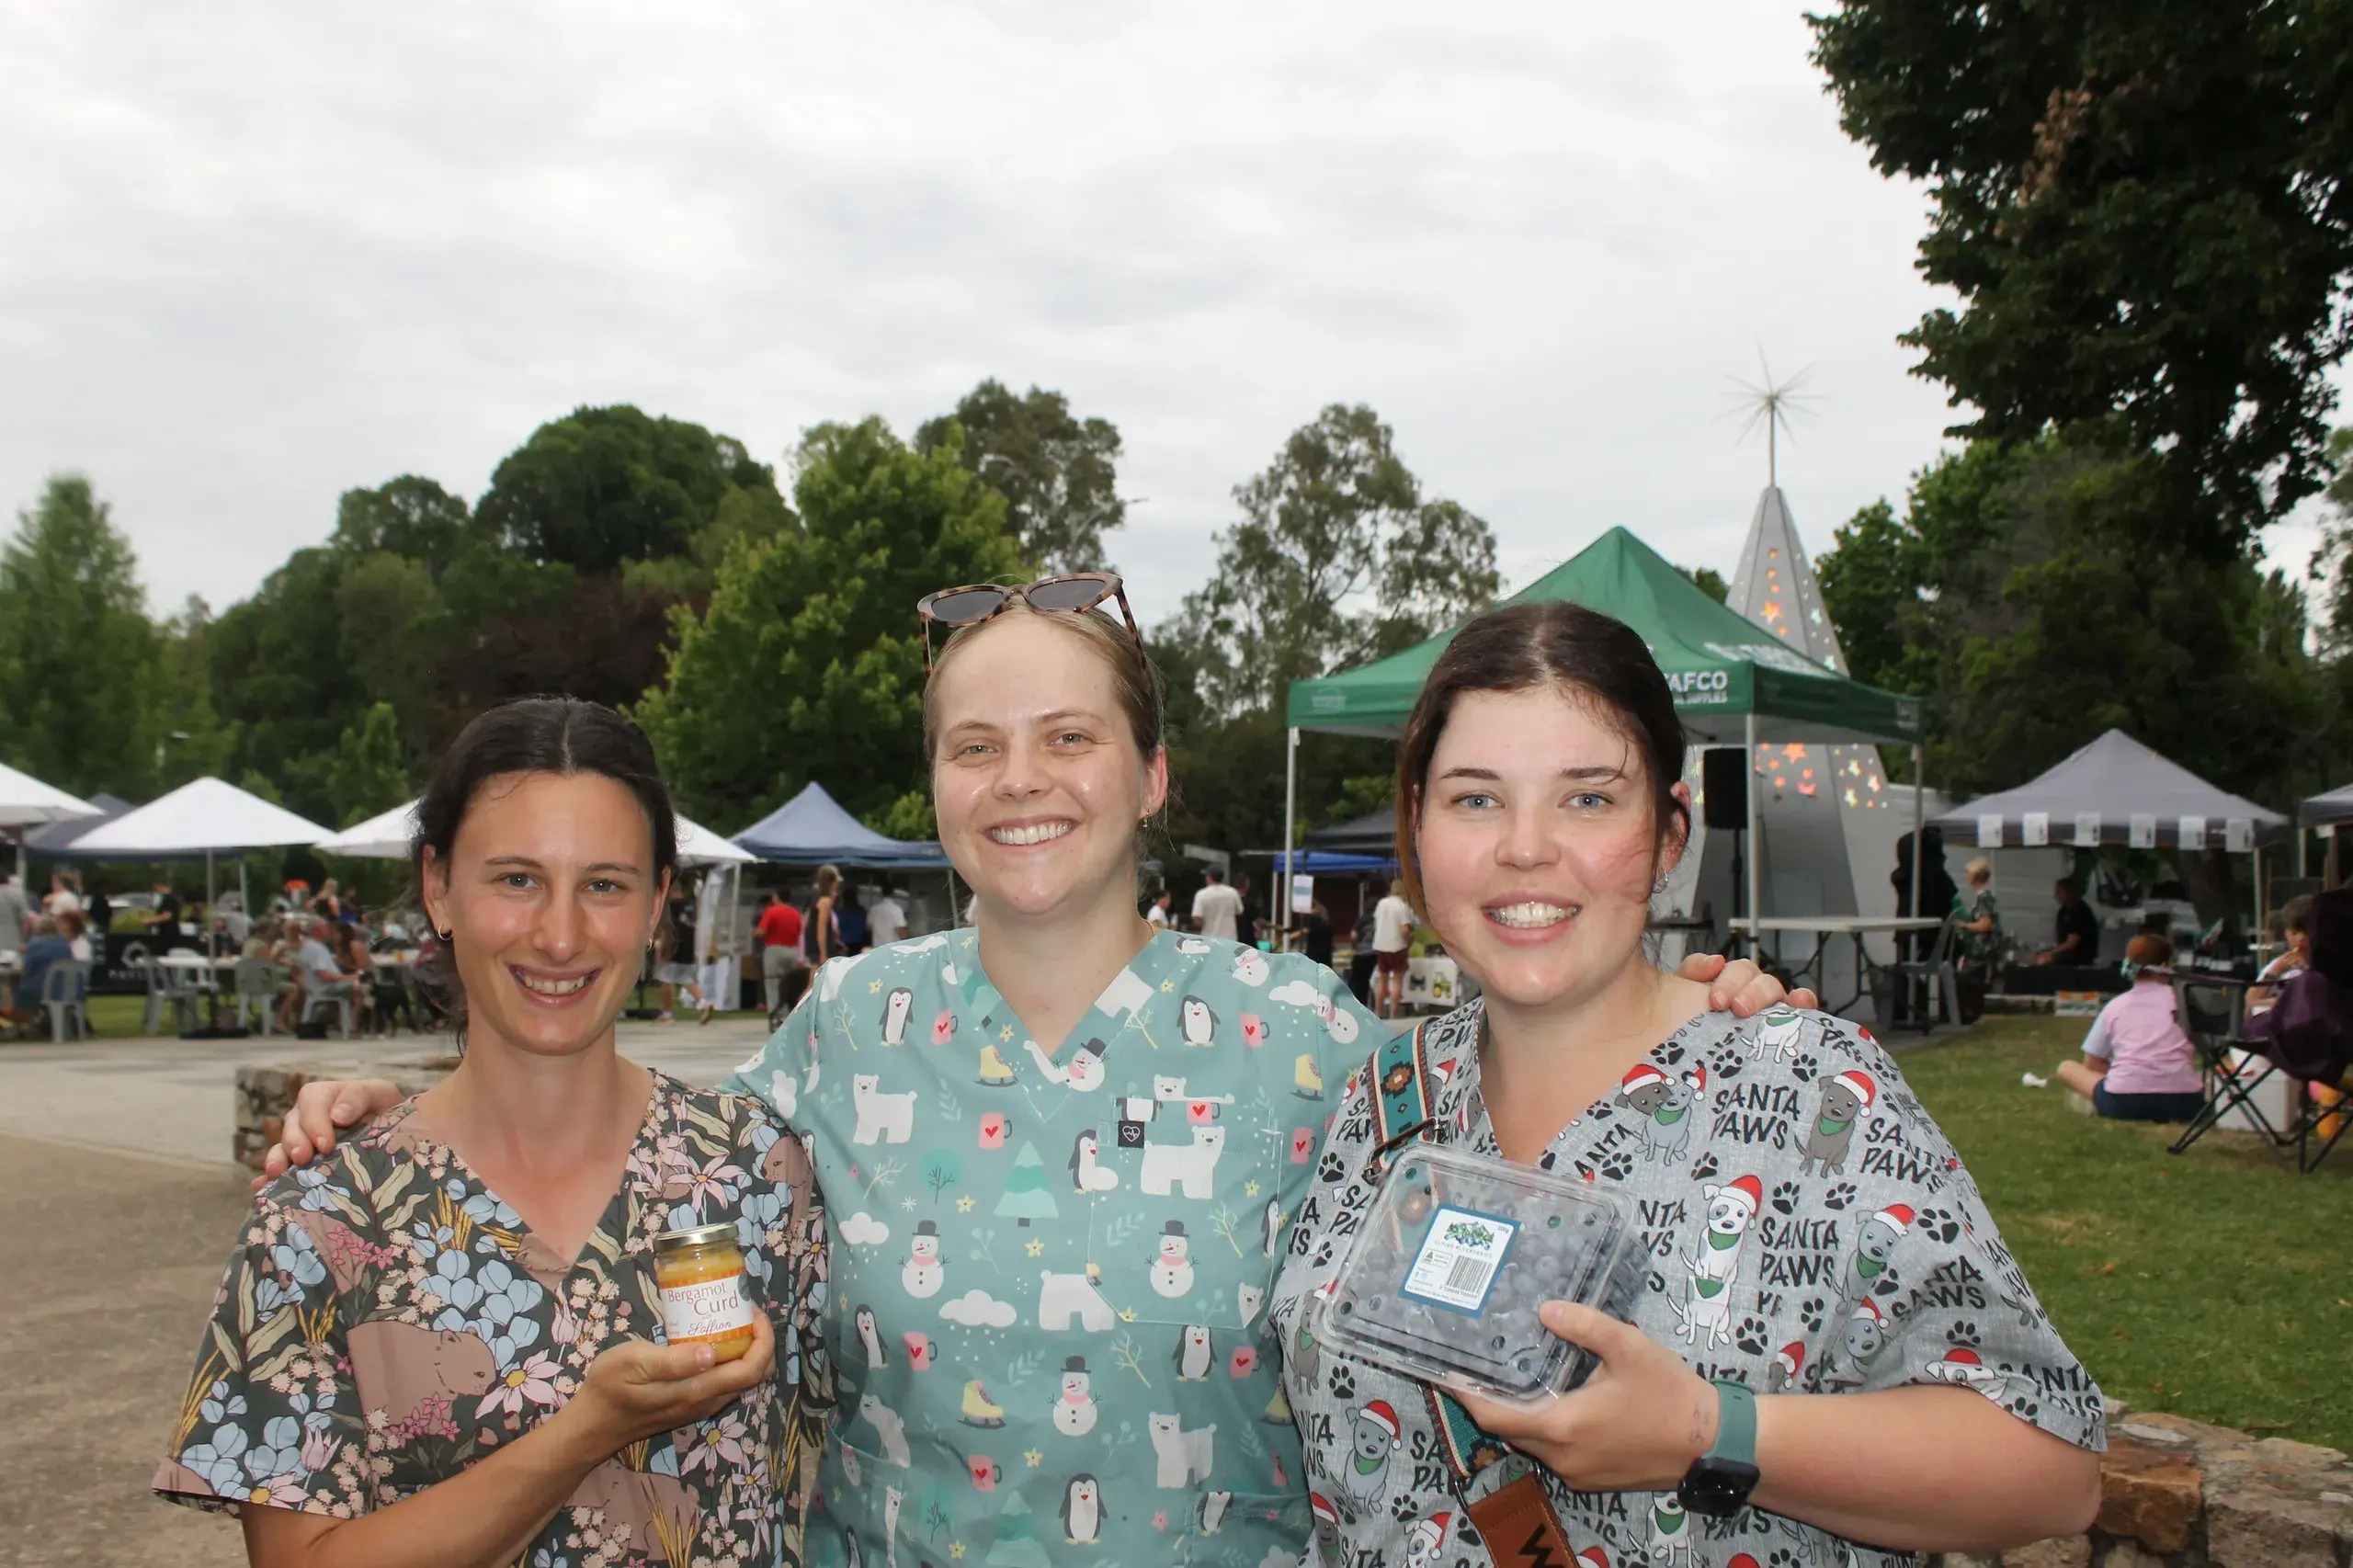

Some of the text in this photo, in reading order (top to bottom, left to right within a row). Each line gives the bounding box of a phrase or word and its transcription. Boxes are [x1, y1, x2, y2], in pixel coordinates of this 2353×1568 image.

[1711, 1083, 1801, 1121] SANTA
[1710, 1111, 1789, 1150] PAWS
[1758, 1216, 1840, 1251] SANTA
[1759, 1252, 1835, 1288] PAWS
[668, 1281, 727, 1305] Bergamot
[693, 1290, 740, 1316] Curd
[688, 1319, 733, 1336] Saffron
